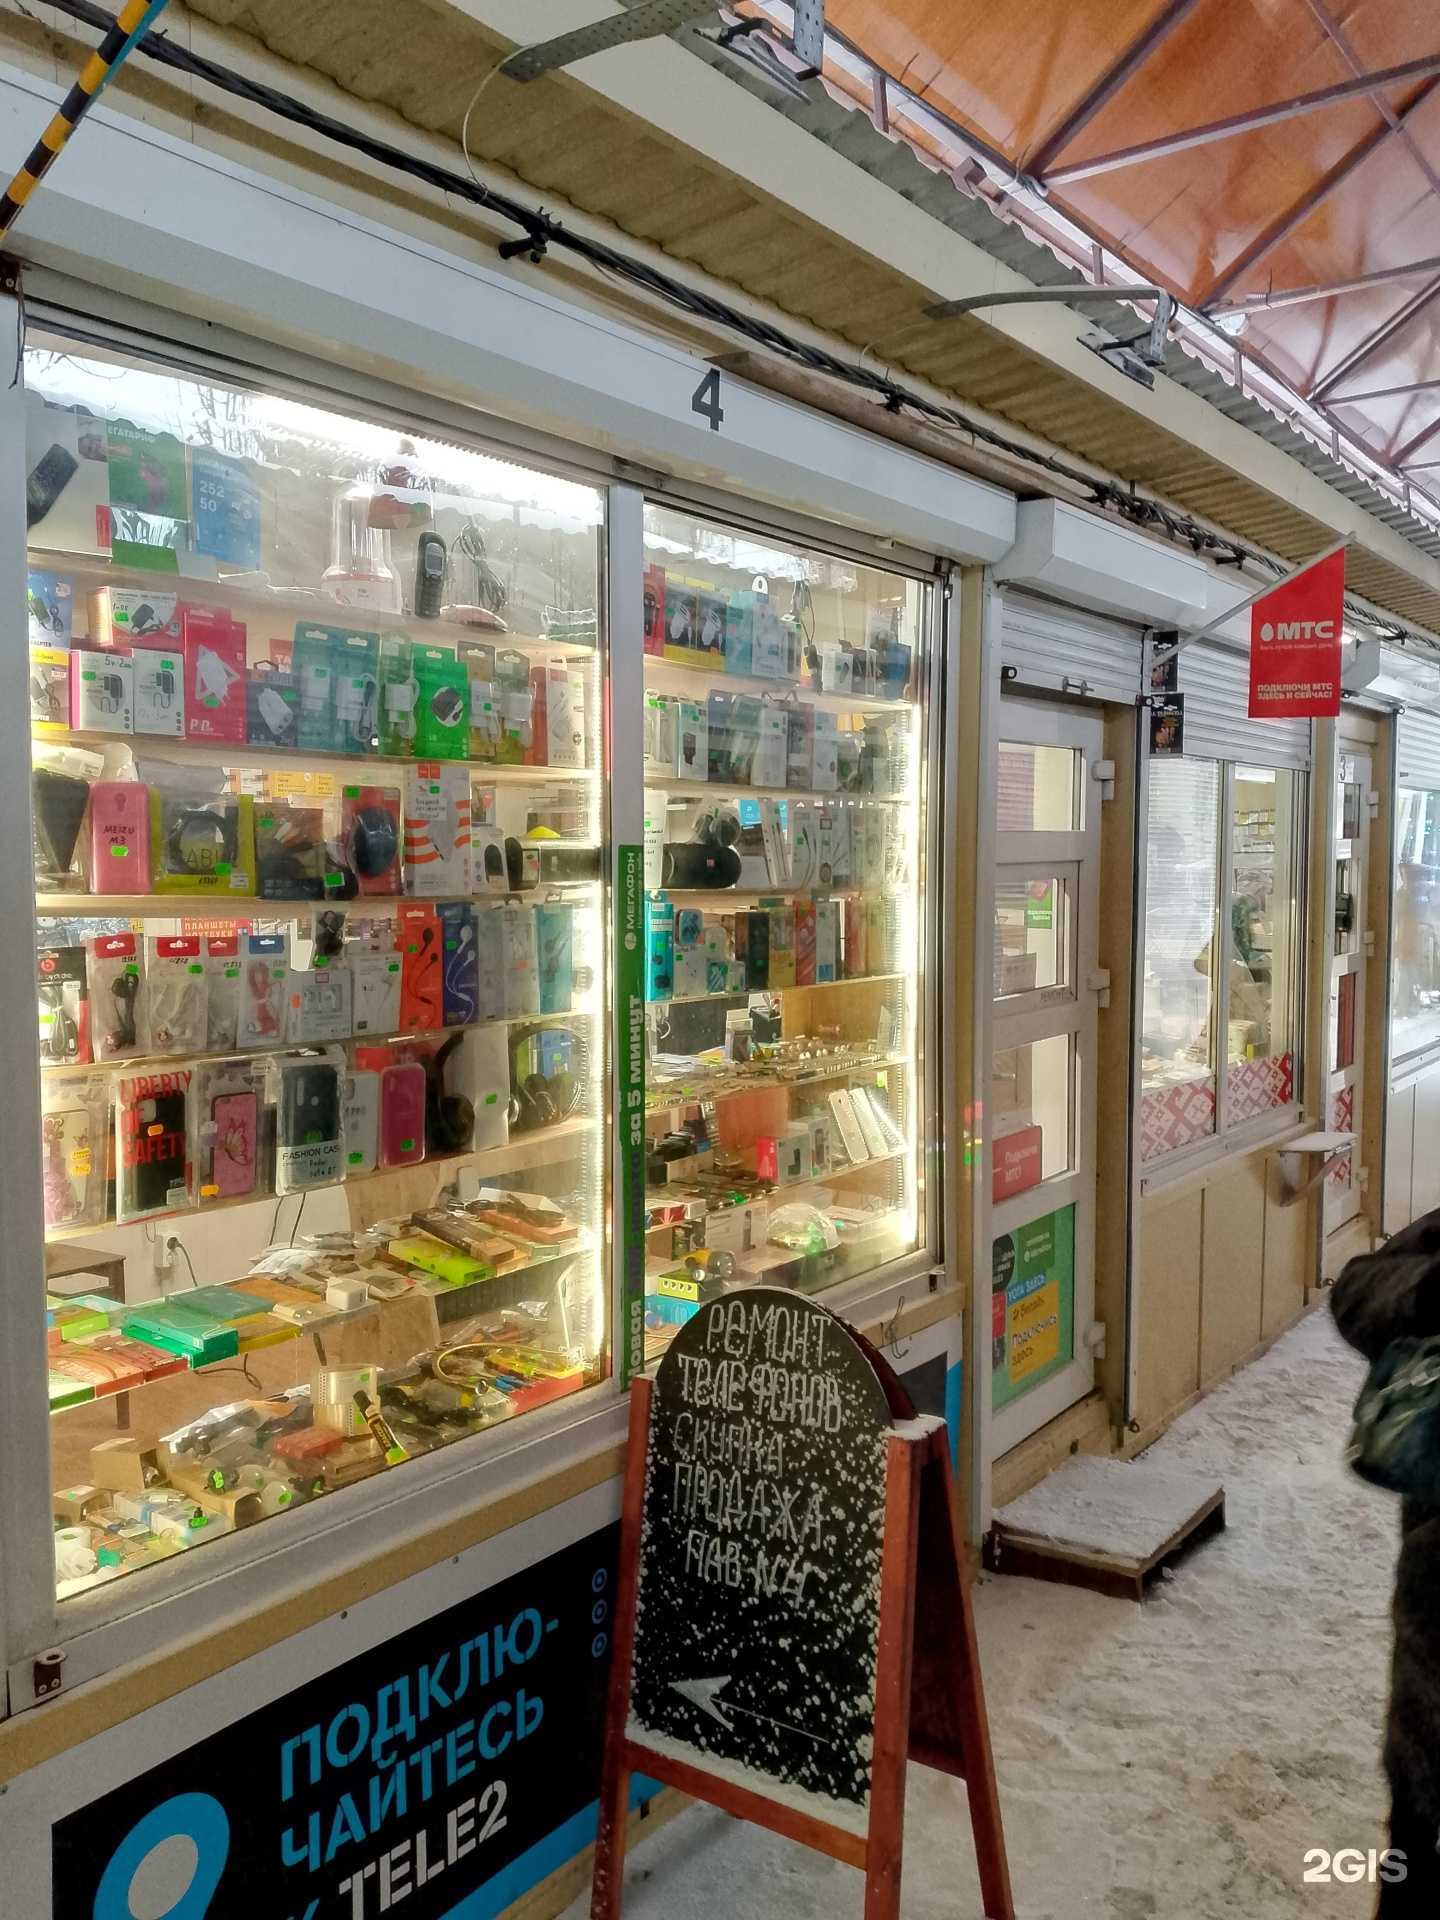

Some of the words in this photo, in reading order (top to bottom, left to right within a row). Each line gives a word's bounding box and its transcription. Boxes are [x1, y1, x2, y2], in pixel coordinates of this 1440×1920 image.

[691, 367, 724, 432] 4
[199, 480, 225, 498] 252
[199, 496, 217, 512] 50
[1277, 620, 1335, 641] МТС
[1257, 683, 1311, 693] ПОДКЛЮЧИ
[1312, 682, 1333, 690] МТС
[103, 825, 136, 835] MEIZU
[184, 920, 237, 930] ПЛАНШЕТЫ
[629, 994, 644, 1084] минут
[119, 1070, 193, 1104] LIBERTY
[627, 1089, 642, 1108] 5
[121, 1107, 144, 1136] OF
[629, 1112, 642, 1147] за
[122, 1132, 187, 1169] SAFETY
[282, 1147, 321, 1161] FASHION
[706, 1300, 832, 1367] РЕМОНТ
[677, 1353, 842, 1433] ТЕЛЕФОНОВ
[671, 1411, 784, 1478] СКУПКА
[672, 1462, 826, 1550] ПРОДАЖА
[685, 1529, 742, 1588] ПАВ
[280, 1606, 560, 1803] ПОДКЛЮ-
[280, 1687, 546, 1873] ЧАЙТЕСЬ
[339, 1779, 509, 1920] TELE2
